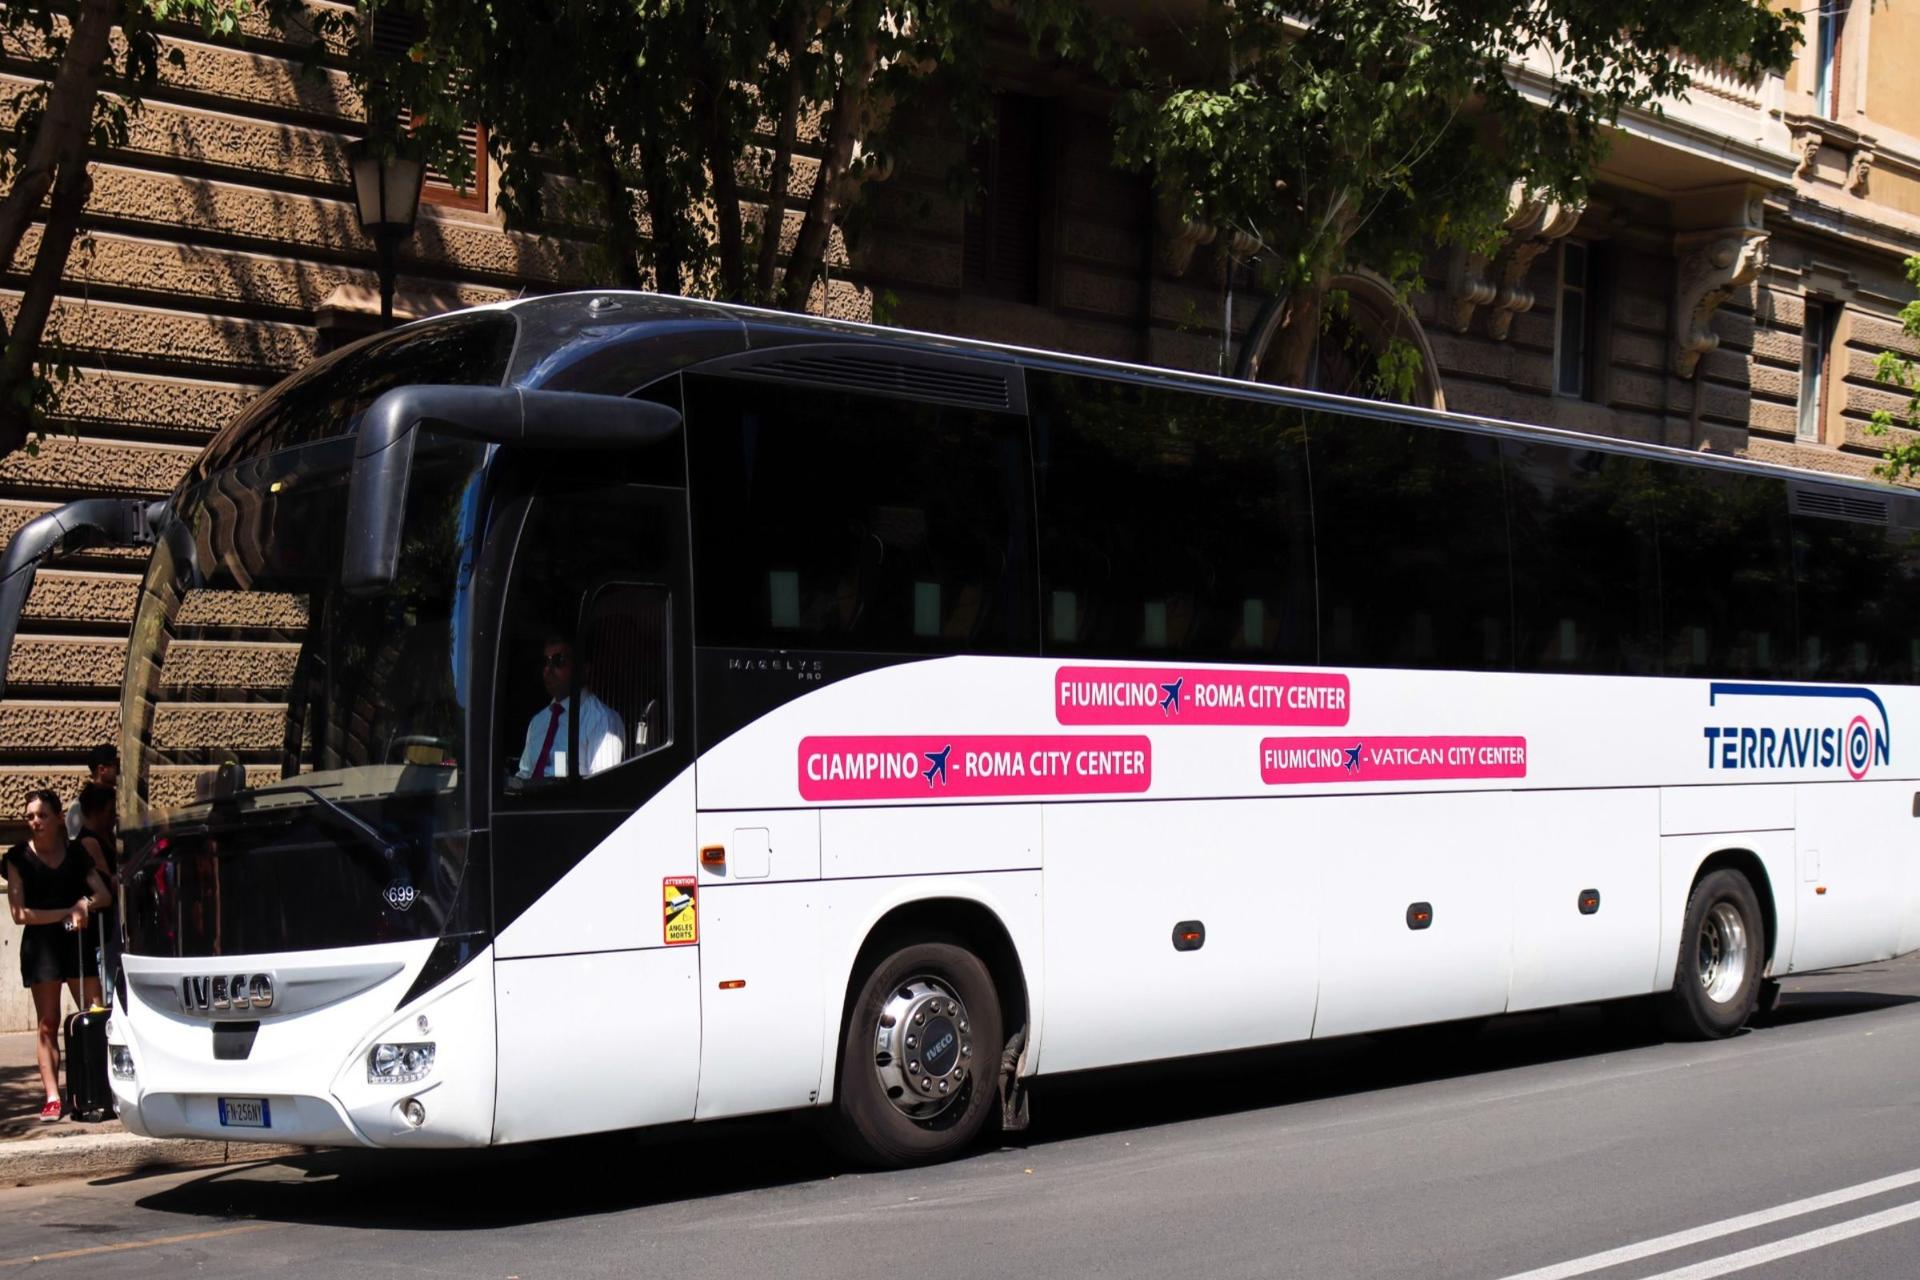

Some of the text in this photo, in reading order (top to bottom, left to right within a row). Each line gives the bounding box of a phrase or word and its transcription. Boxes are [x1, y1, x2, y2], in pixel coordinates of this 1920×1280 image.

[1060, 681, 1158, 706] FIUMICINO
[1195, 684, 1246, 708] ROMA
[1248, 685, 1284, 709] CITY
[1287, 686, 1346, 710] CENTER
[1264, 748, 1342, 769] FIUMICINO
[1370, 747, 1444, 765] VATICAN
[1447, 746, 1476, 765] CITY
[1478, 747, 1525, 765] CENTER
[1704, 716, 1889, 780] TERRAVISION
[807, 752, 919, 781] CIAMPINO
[965, 751, 1025, 777] ROMA
[1029, 750, 1072, 776] CITY
[1075, 750, 1145, 775] CENTER
[390, 886, 414, 902] 699
[668, 923, 693, 931] ANGLES
[670, 931, 692, 939] MORTS
[183, 973, 273, 1010] IVECO
[926, 1033, 953, 1060] IVECO
